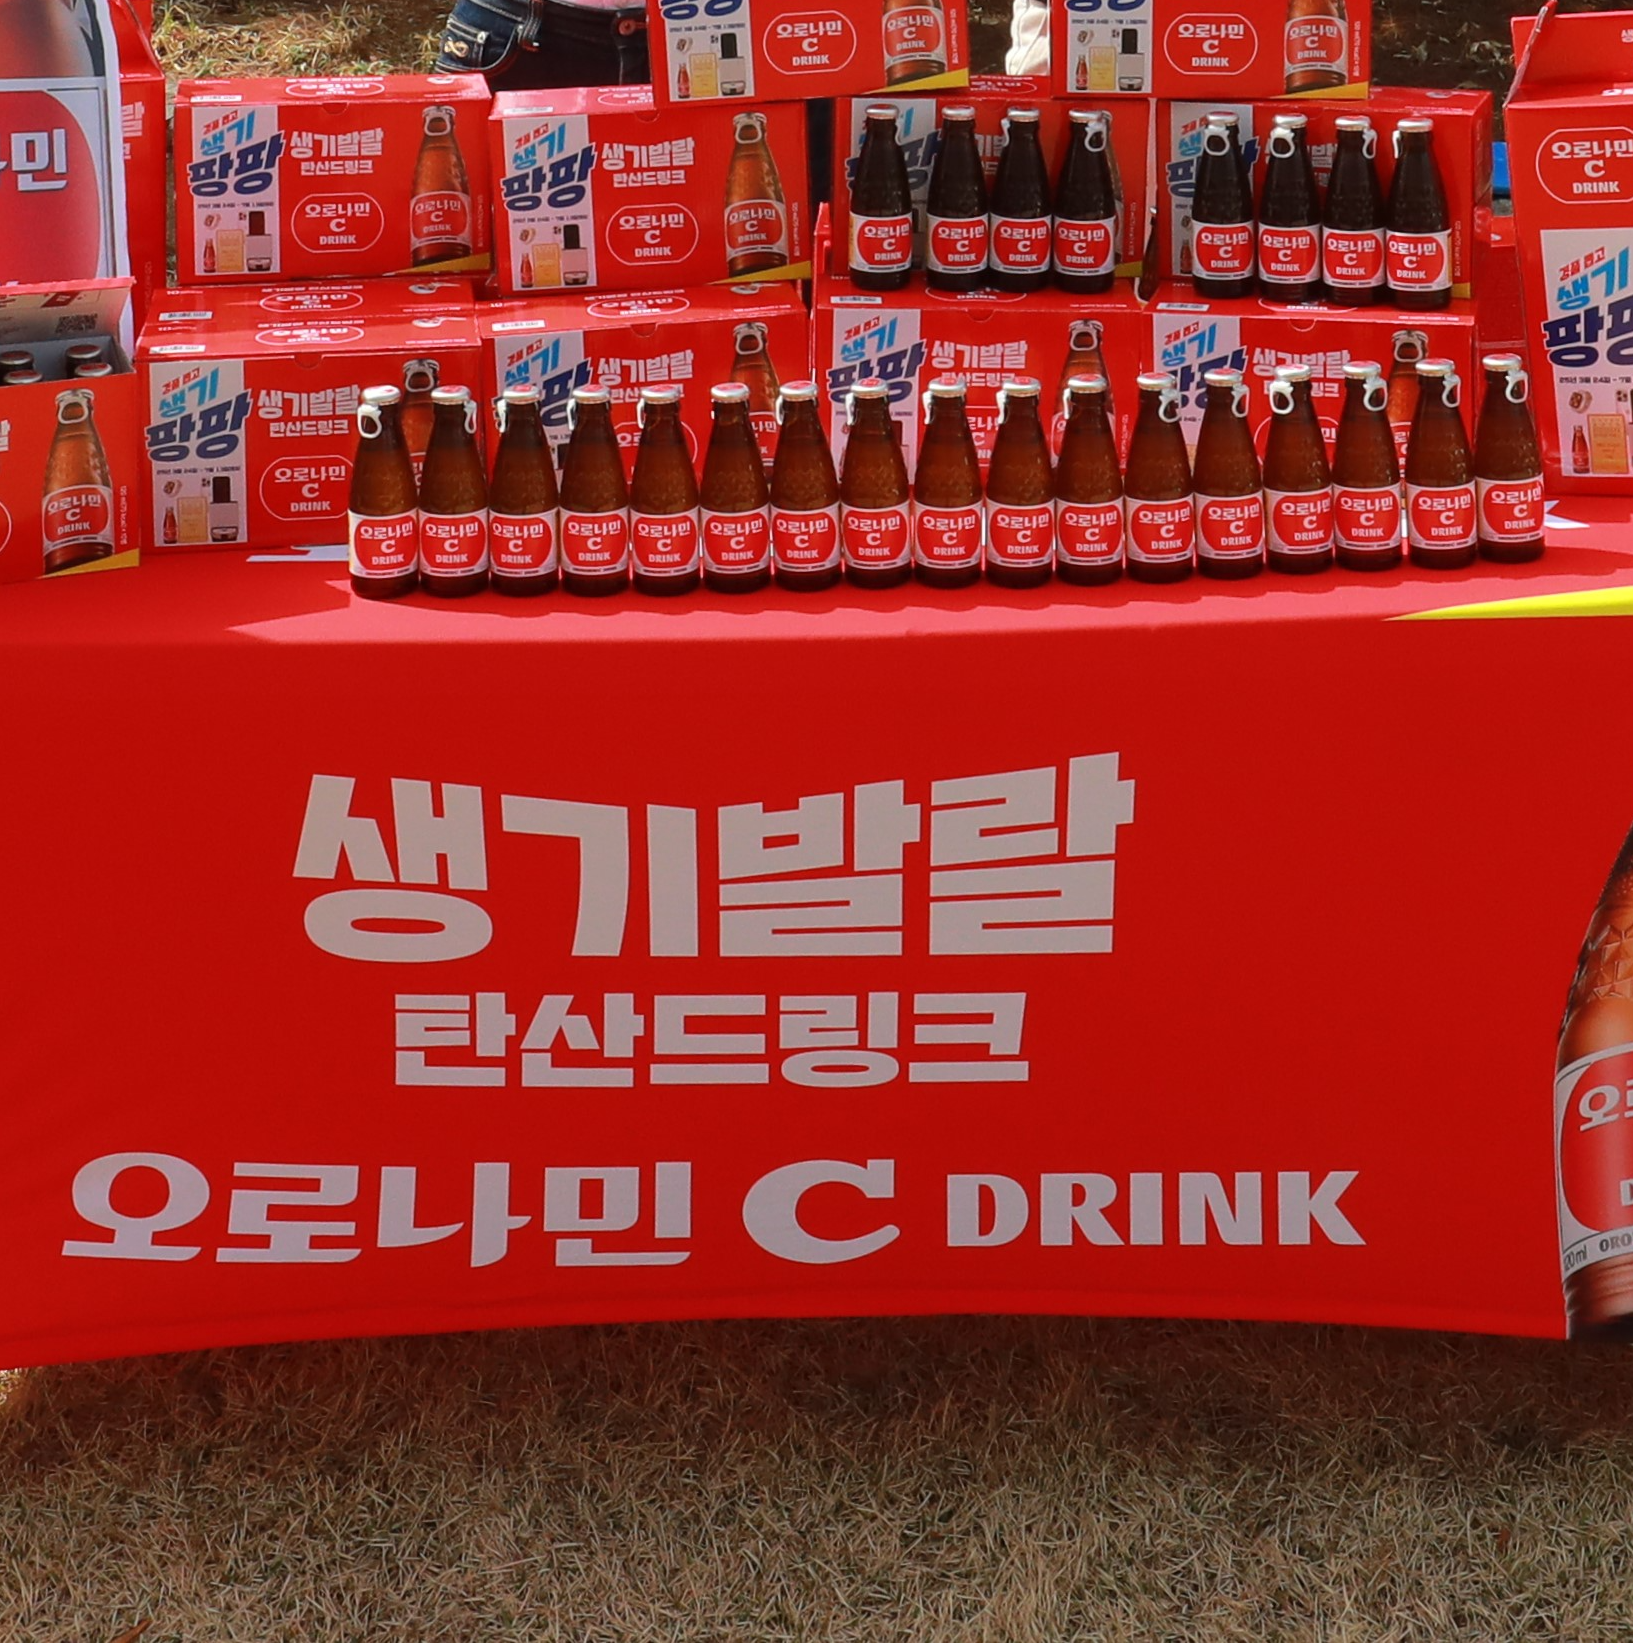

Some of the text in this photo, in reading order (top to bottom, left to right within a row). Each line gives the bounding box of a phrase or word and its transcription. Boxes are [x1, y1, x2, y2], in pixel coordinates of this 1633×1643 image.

[290, 127, 384, 158] 생기발랄
[602, 137, 695, 170] 생기발랄
[301, 160, 373, 176] 탄산드링크
[1584, 159, 1606, 178] C
[1572, 181, 1620, 195] DRINK
[305, 201, 371, 218] 오로나민
[329, 218, 346, 233] C
[319, 234, 356, 246] DRINK
[1201, 232, 1249, 246] 오로나민
[1219, 246, 1232, 258] C
[1210, 260, 1240, 268] DRINK
[1557, 247, 1630, 311] 생기
[1340, 495, 1394, 513] 오로나민
[1359, 512, 1374, 525] C
[360, 522, 413, 540] 오로나민
[1351, 527, 1384, 538] DRINK
[381, 540, 396, 553] C
[372, 554, 404, 565] DRINK
[291, 751, 1136, 963] 생기발랄
[393, 991, 1029, 1088] 탄산드링크
[60, 1150, 1367, 1270] 오로나민 C DRINK
